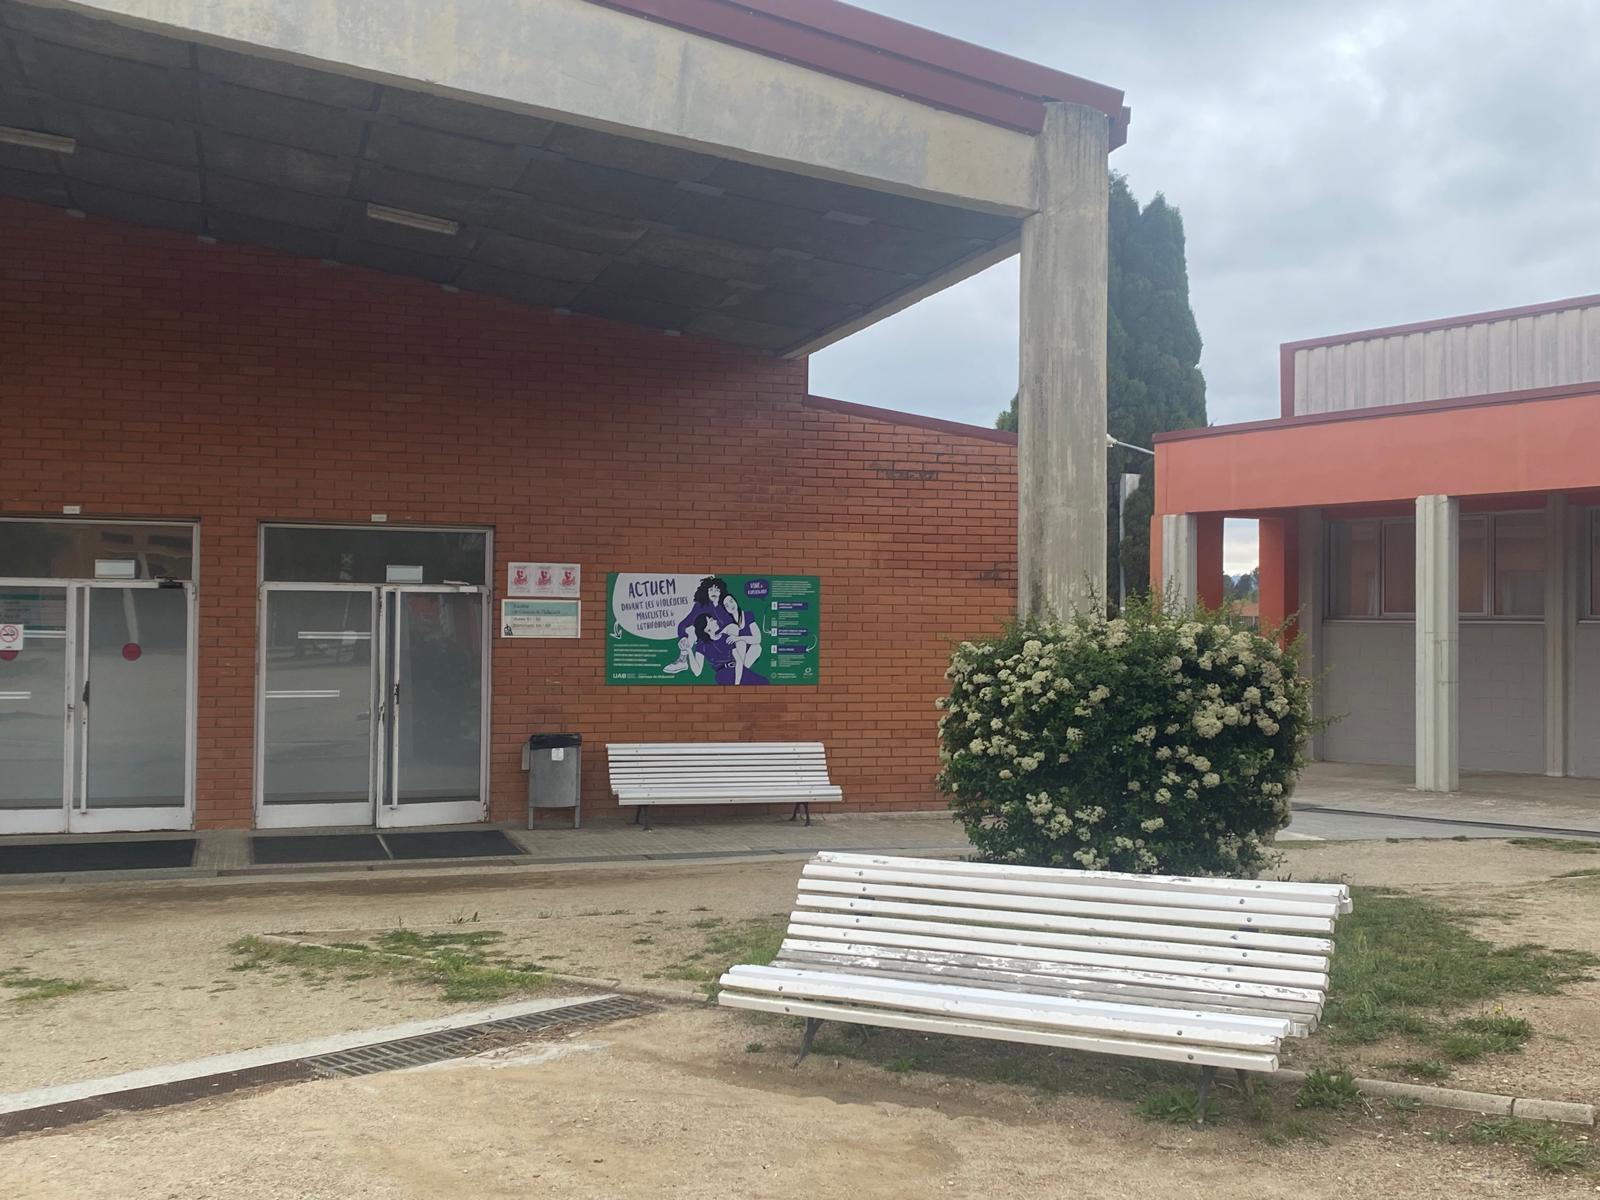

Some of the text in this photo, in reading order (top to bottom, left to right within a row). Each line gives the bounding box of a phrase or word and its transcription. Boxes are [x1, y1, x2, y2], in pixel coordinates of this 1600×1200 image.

[628, 578, 676, 599] ACTUEM
[621, 601, 643, 611] DAVANT
[645, 600, 655, 609] LES
[636, 610, 669, 620] MASCLISTES
